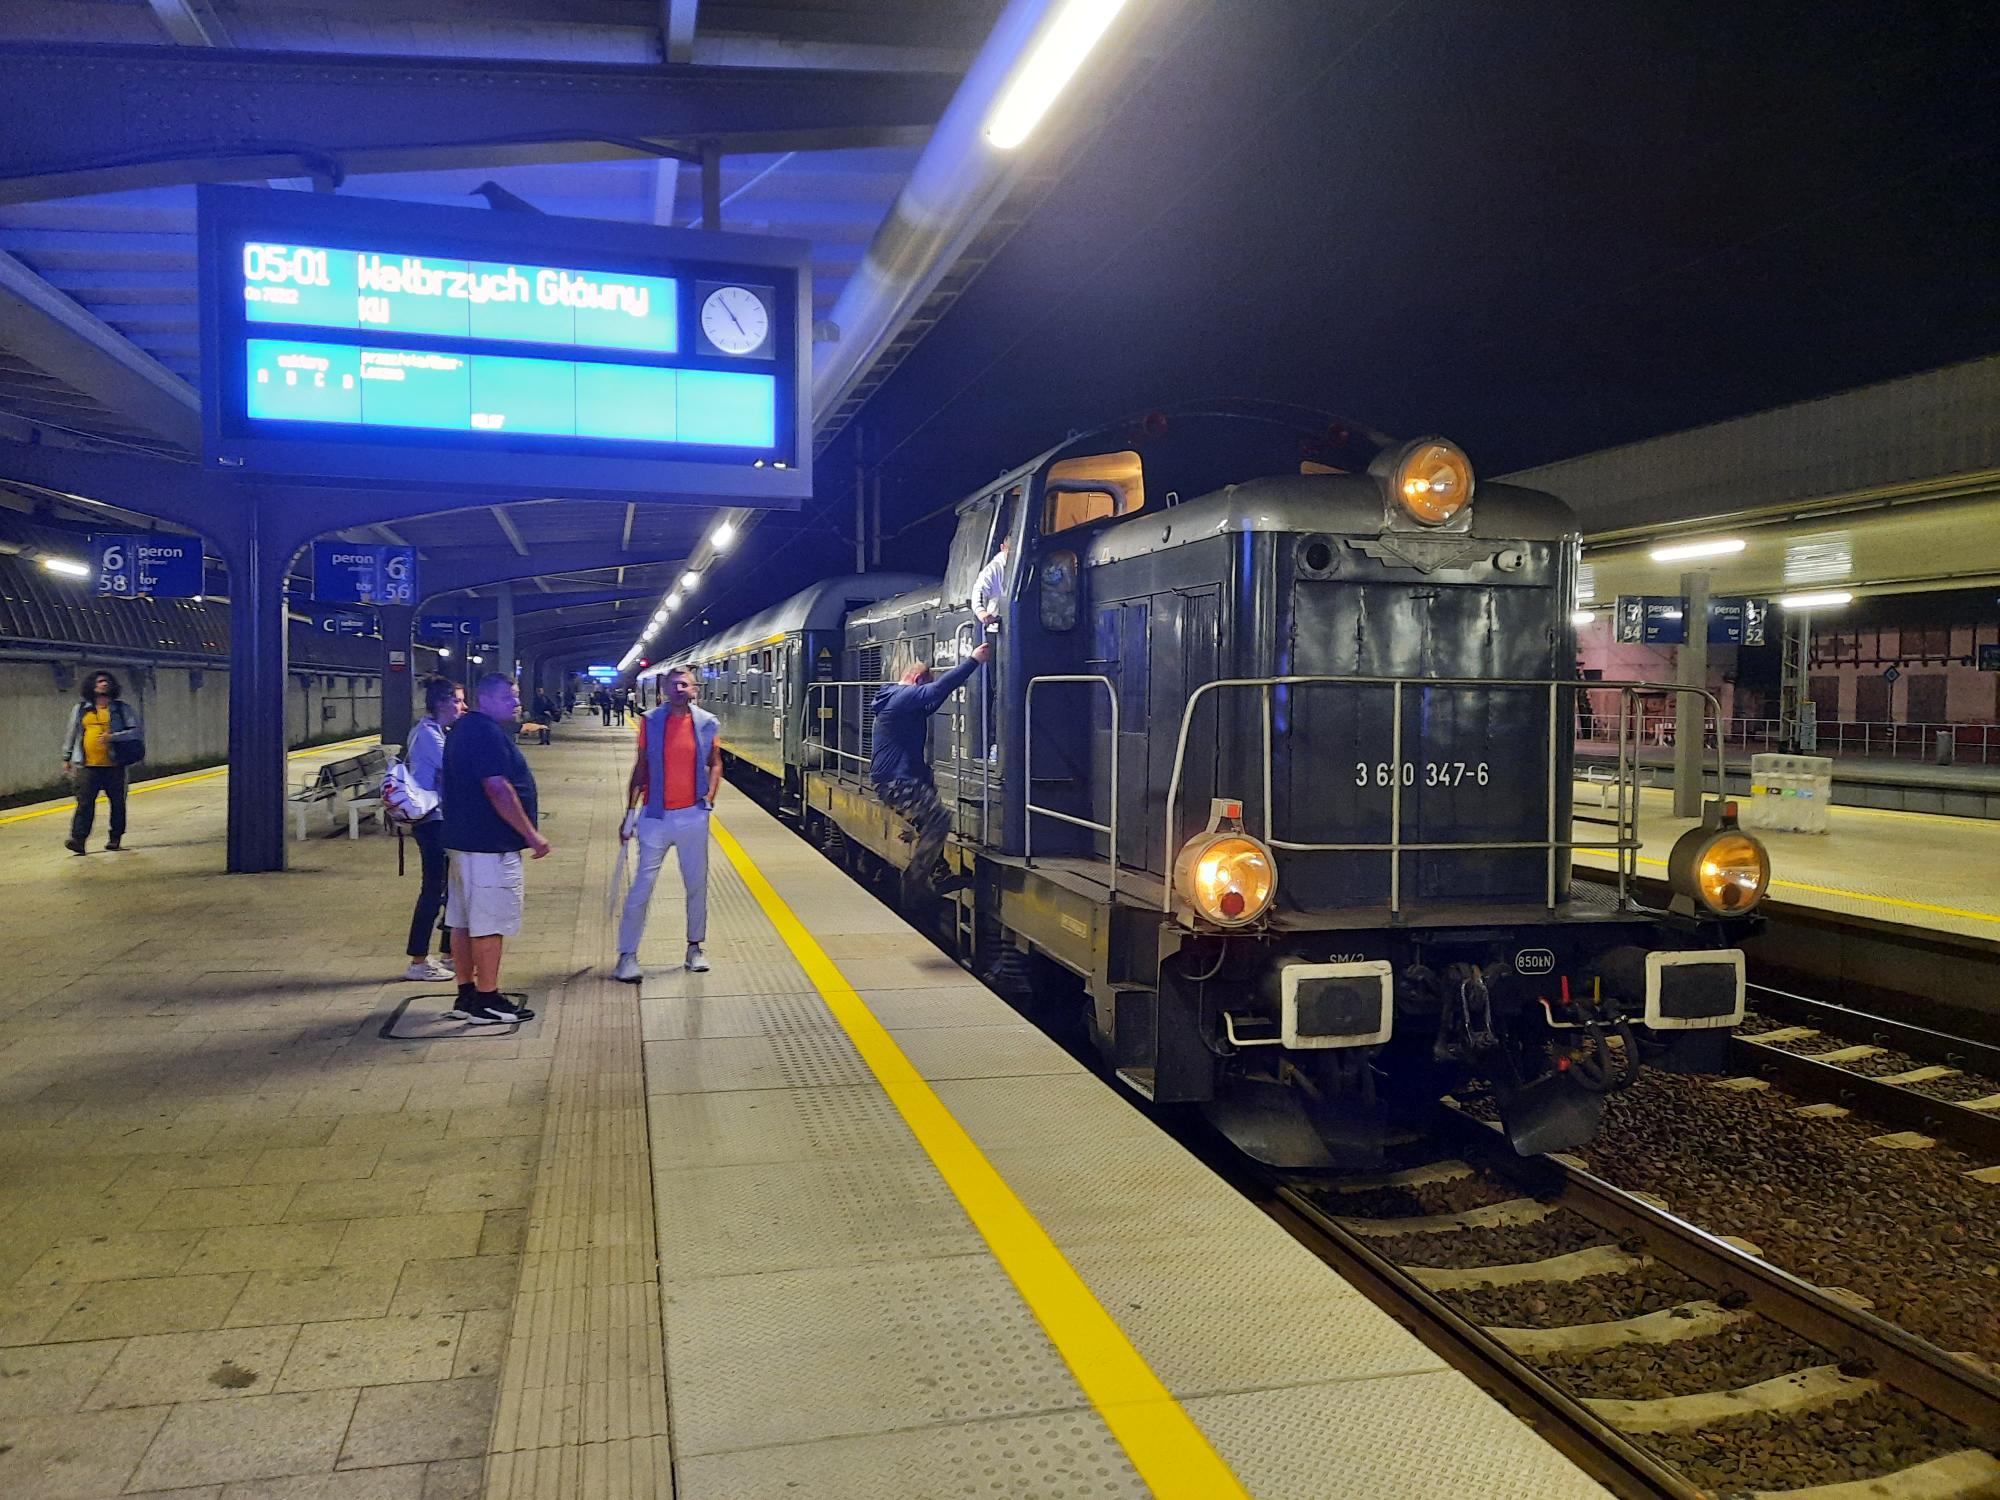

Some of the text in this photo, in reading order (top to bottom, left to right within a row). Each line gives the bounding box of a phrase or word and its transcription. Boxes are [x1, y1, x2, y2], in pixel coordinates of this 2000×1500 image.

[244, 245, 649, 317] 05:01 Wałbrzych Główny
[103, 545, 124, 570] 6
[138, 547, 183, 559] peron
[332, 554, 406, 580] peron 6
[99, 572, 158, 592] 58 tor
[355, 582, 410, 599] tor 56
[323, 619, 334, 632] C
[460, 621, 471, 634] C
[1746, 628, 1763, 642] 52
[1355, 762, 1368, 787] 3
[1425, 762, 1489, 787] 347-6
[1518, 955, 1551, 968] 850kN
